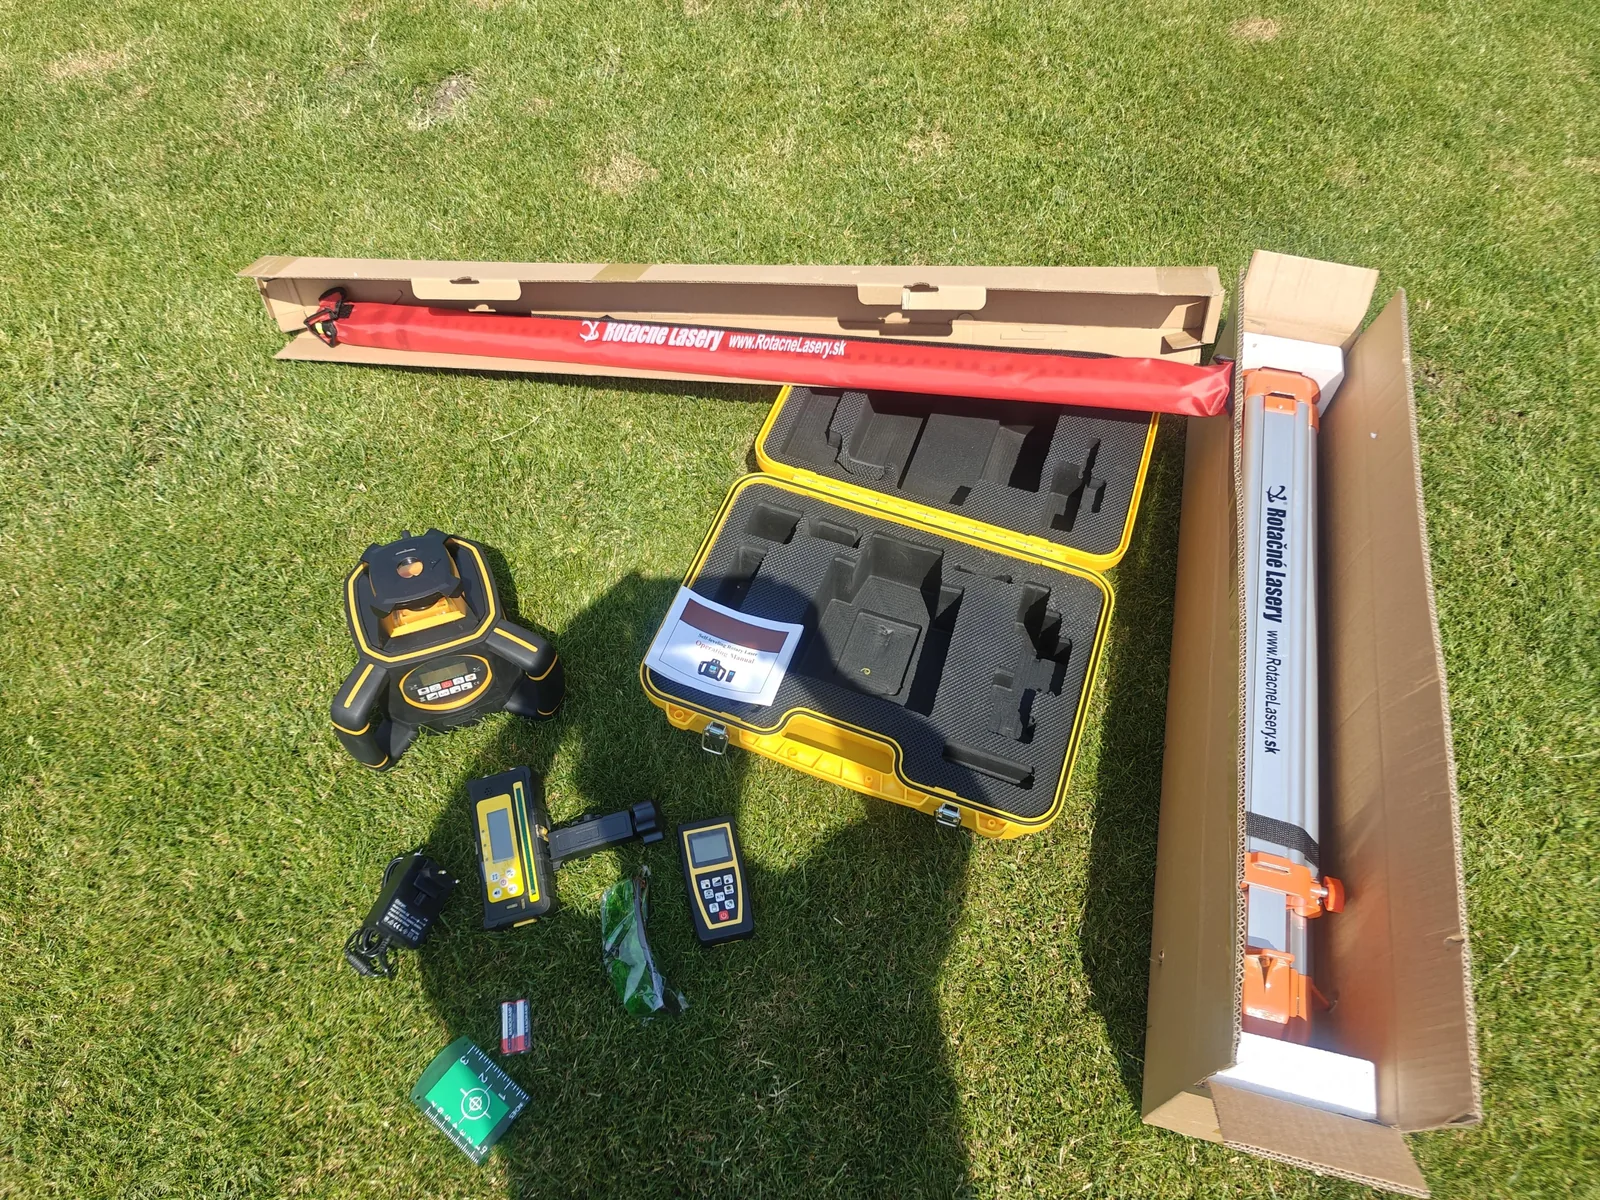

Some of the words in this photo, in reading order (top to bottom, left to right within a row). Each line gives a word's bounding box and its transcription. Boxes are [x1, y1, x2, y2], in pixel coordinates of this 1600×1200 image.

[668, 327, 725, 352] Lasery
[728, 333, 846, 359] www.RotacneLasery.sk
[1266, 507, 1288, 568] Rotačné
[1263, 570, 1286, 623] Lasery
[695, 639, 728, 658] Operating
[730, 653, 756, 664] Manual
[1260, 630, 1282, 754] www.RotacneLasery.sk
[478, 1072, 488, 1083] 2
